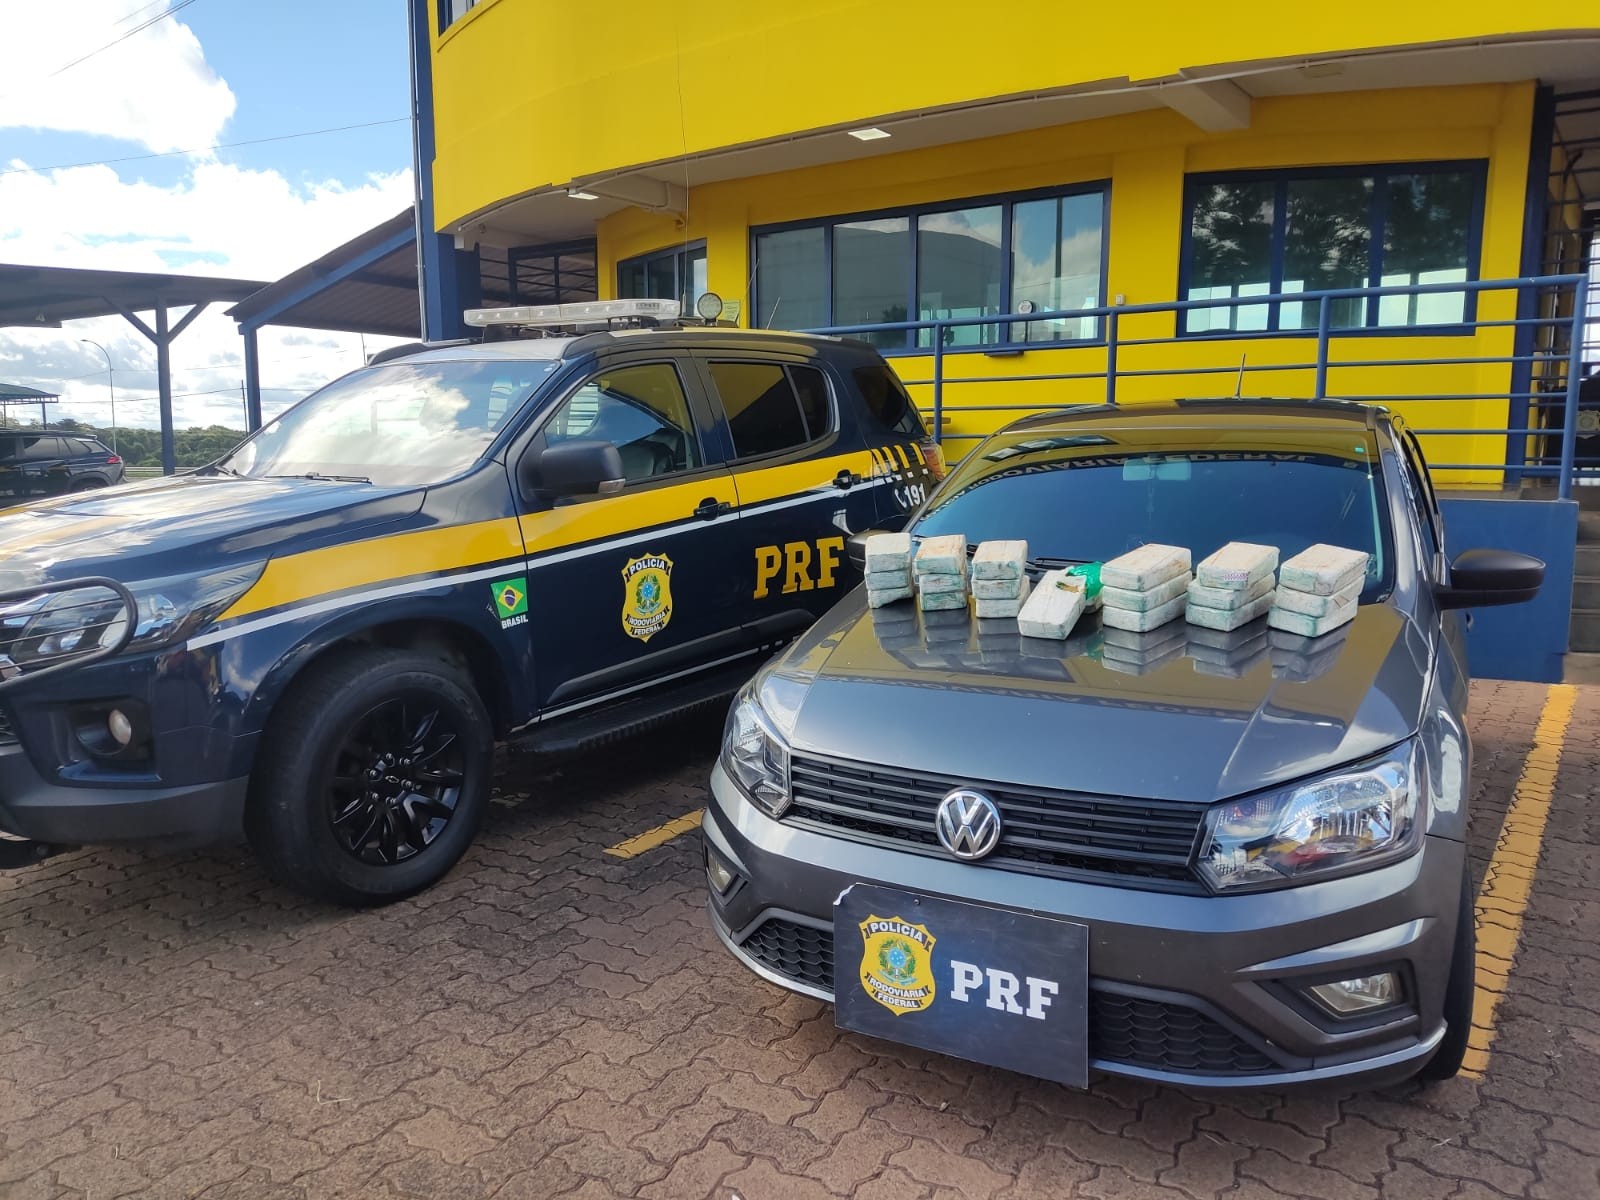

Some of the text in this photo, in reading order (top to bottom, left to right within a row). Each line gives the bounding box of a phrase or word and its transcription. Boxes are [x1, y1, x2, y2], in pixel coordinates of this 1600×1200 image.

[904, 483, 926, 507] 191
[753, 536, 845, 600] PRF
[501, 614, 529, 630] BRASIL
[633, 624, 661, 635] FEDERAL
[950, 959, 1059, 1020] PRF
[877, 992, 919, 1008] FEDERAL
